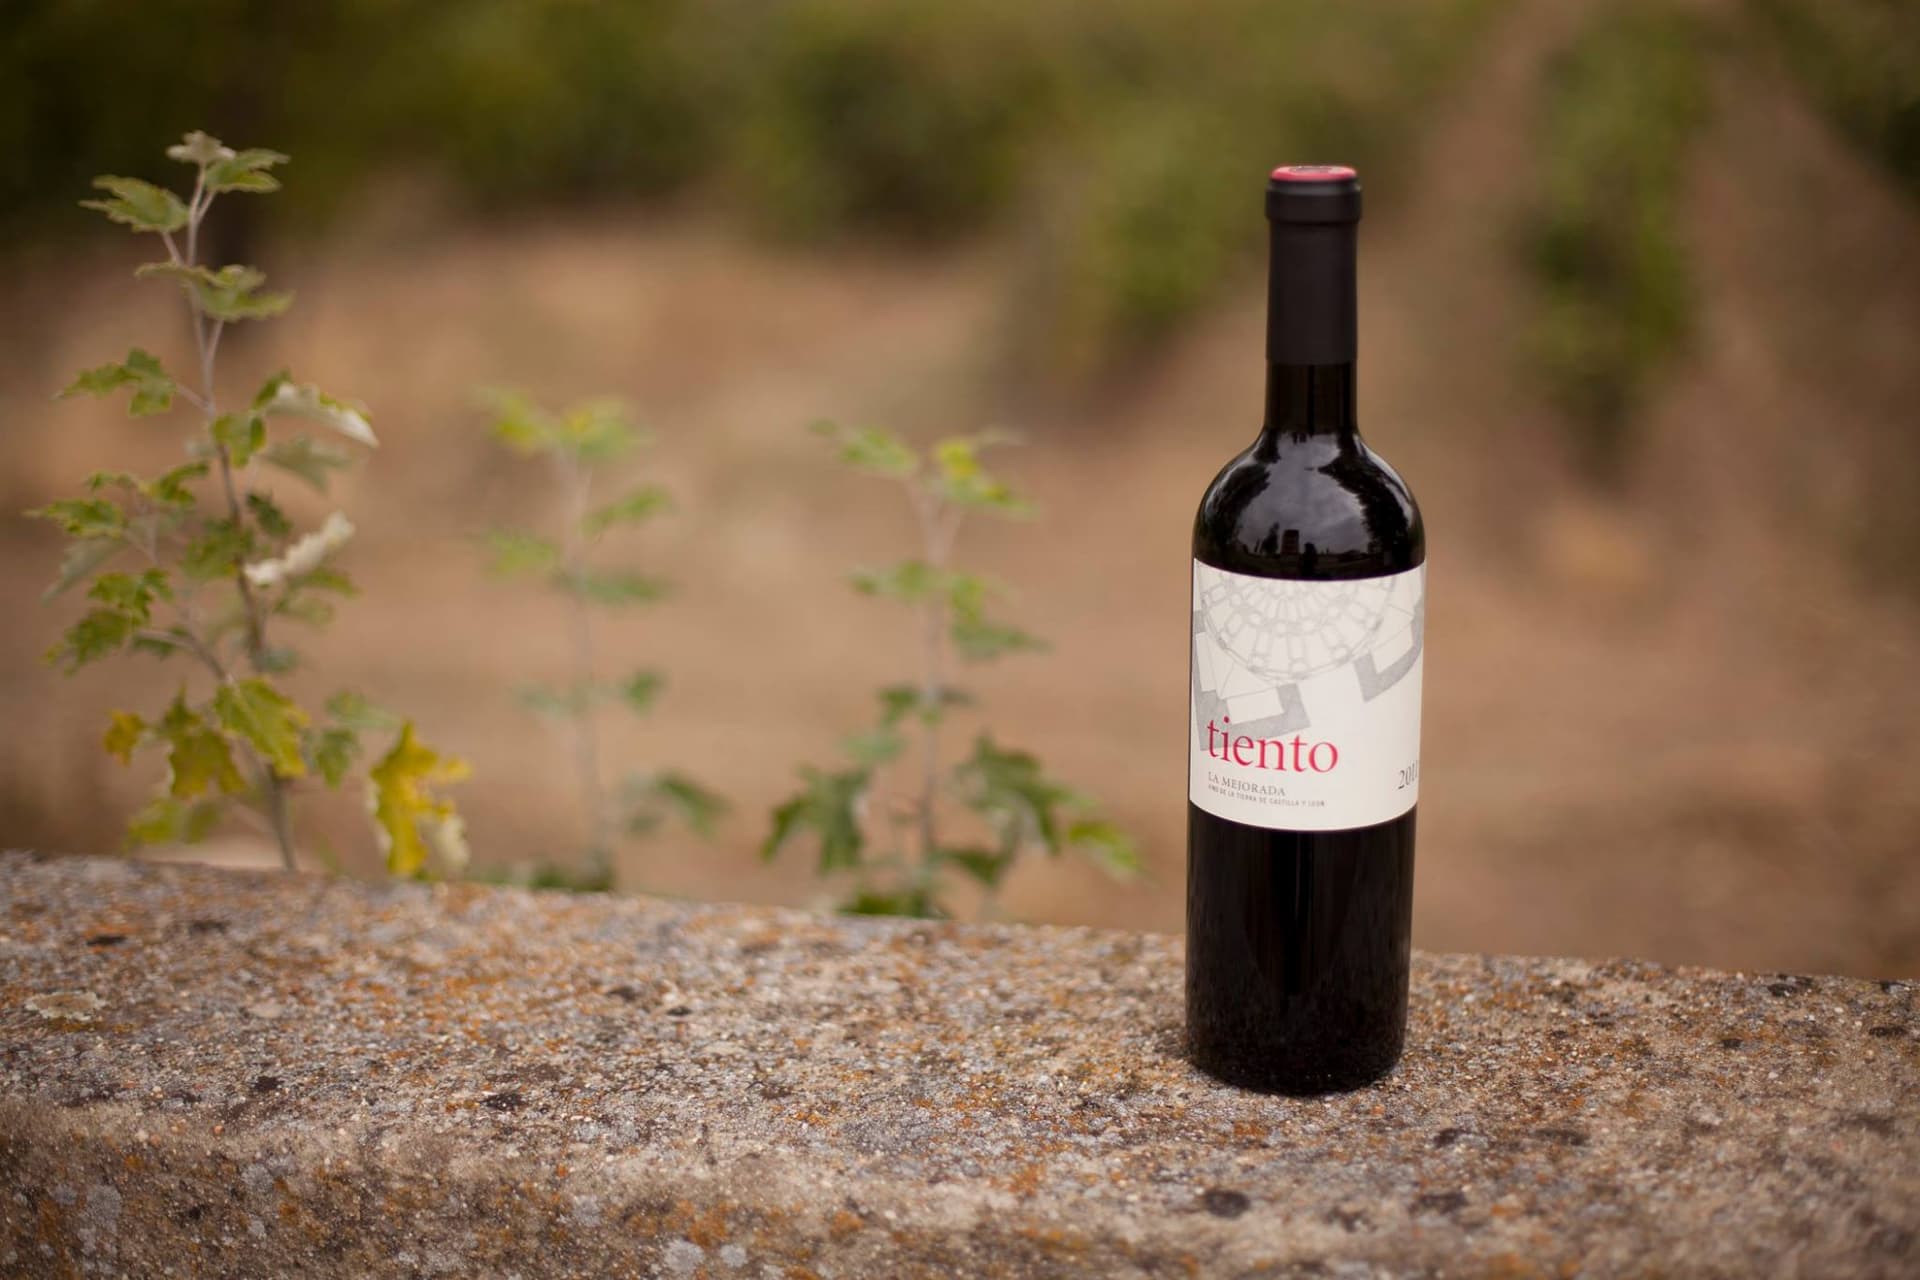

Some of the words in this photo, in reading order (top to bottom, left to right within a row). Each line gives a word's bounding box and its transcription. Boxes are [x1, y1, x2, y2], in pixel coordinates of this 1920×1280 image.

[1207, 716, 1338, 773] tiento
[1208, 771, 1220, 784] LA
[1222, 777, 1286, 796] MEJORADA
